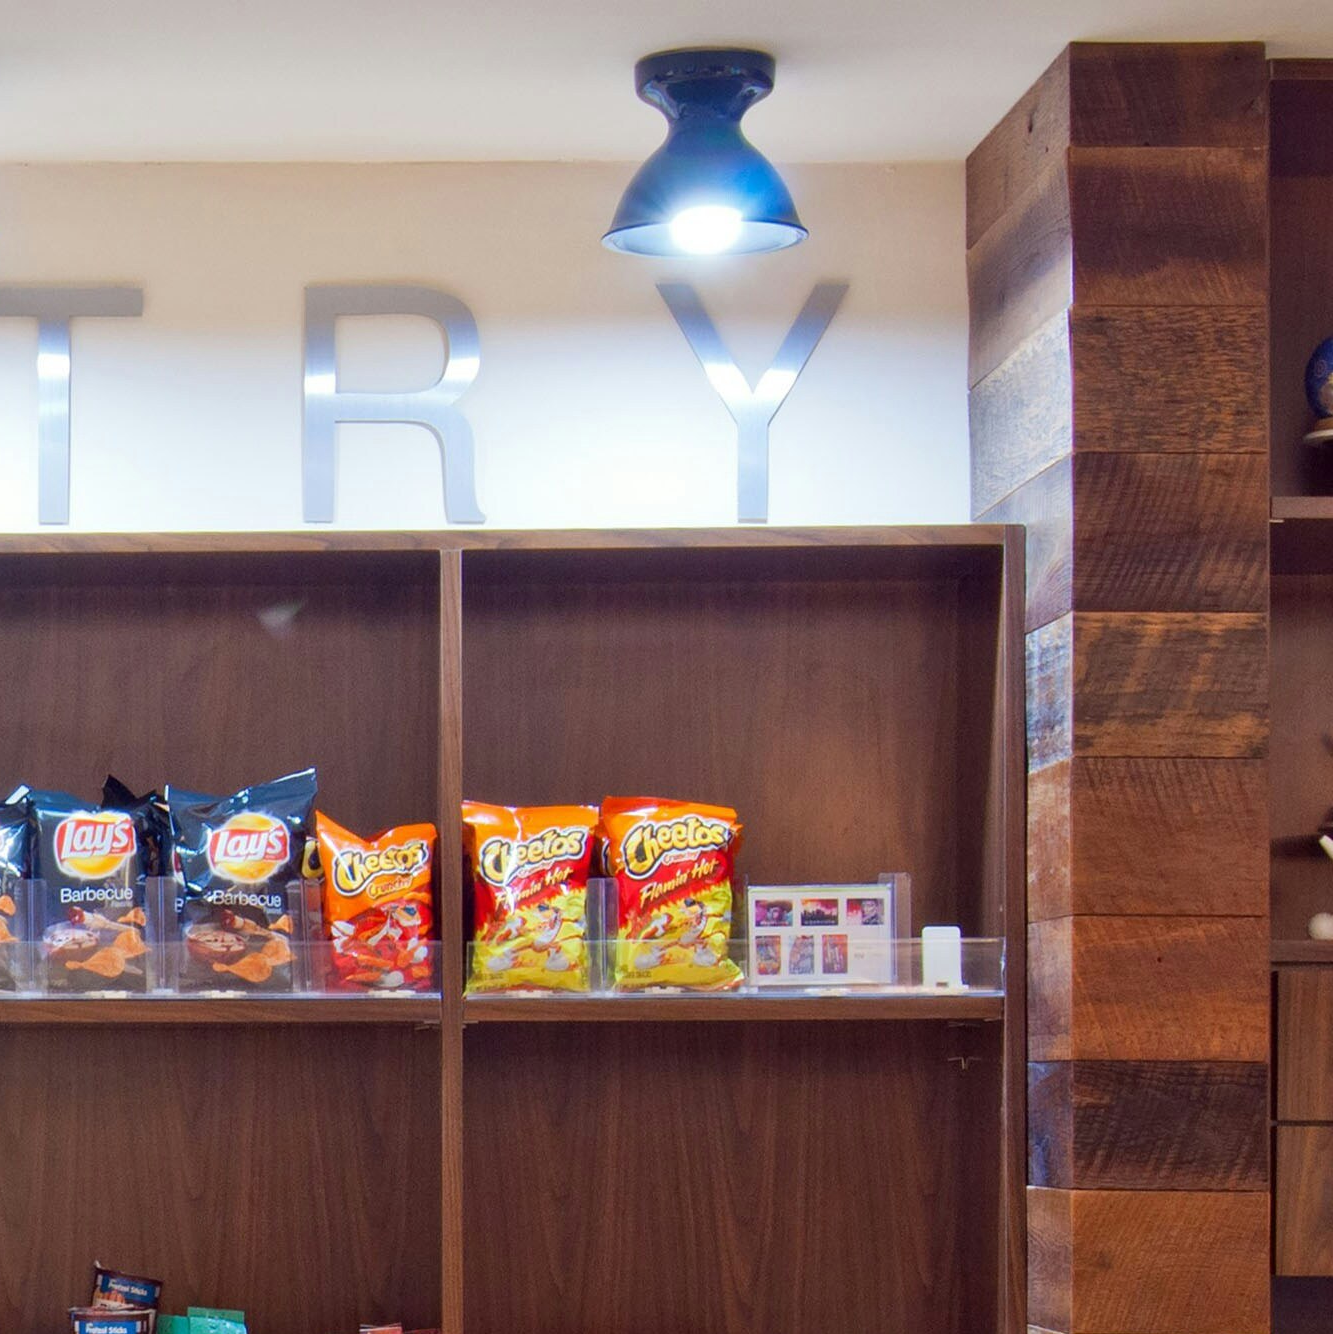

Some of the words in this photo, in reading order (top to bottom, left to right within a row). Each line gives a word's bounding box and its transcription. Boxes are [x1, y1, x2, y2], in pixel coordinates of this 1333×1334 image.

[61, 820, 130, 860] Lay's
[215, 829, 285, 863] Lay's
[482, 829, 584, 884] Cheetos
[624, 816, 729, 876] Cheetos
[336, 842, 426, 892] Cheetos
[545, 866, 573, 887] Hot
[691, 858, 719, 880] Hot
[60, 886, 133, 904] Barbecue
[213, 890, 281, 908] Barbecue
